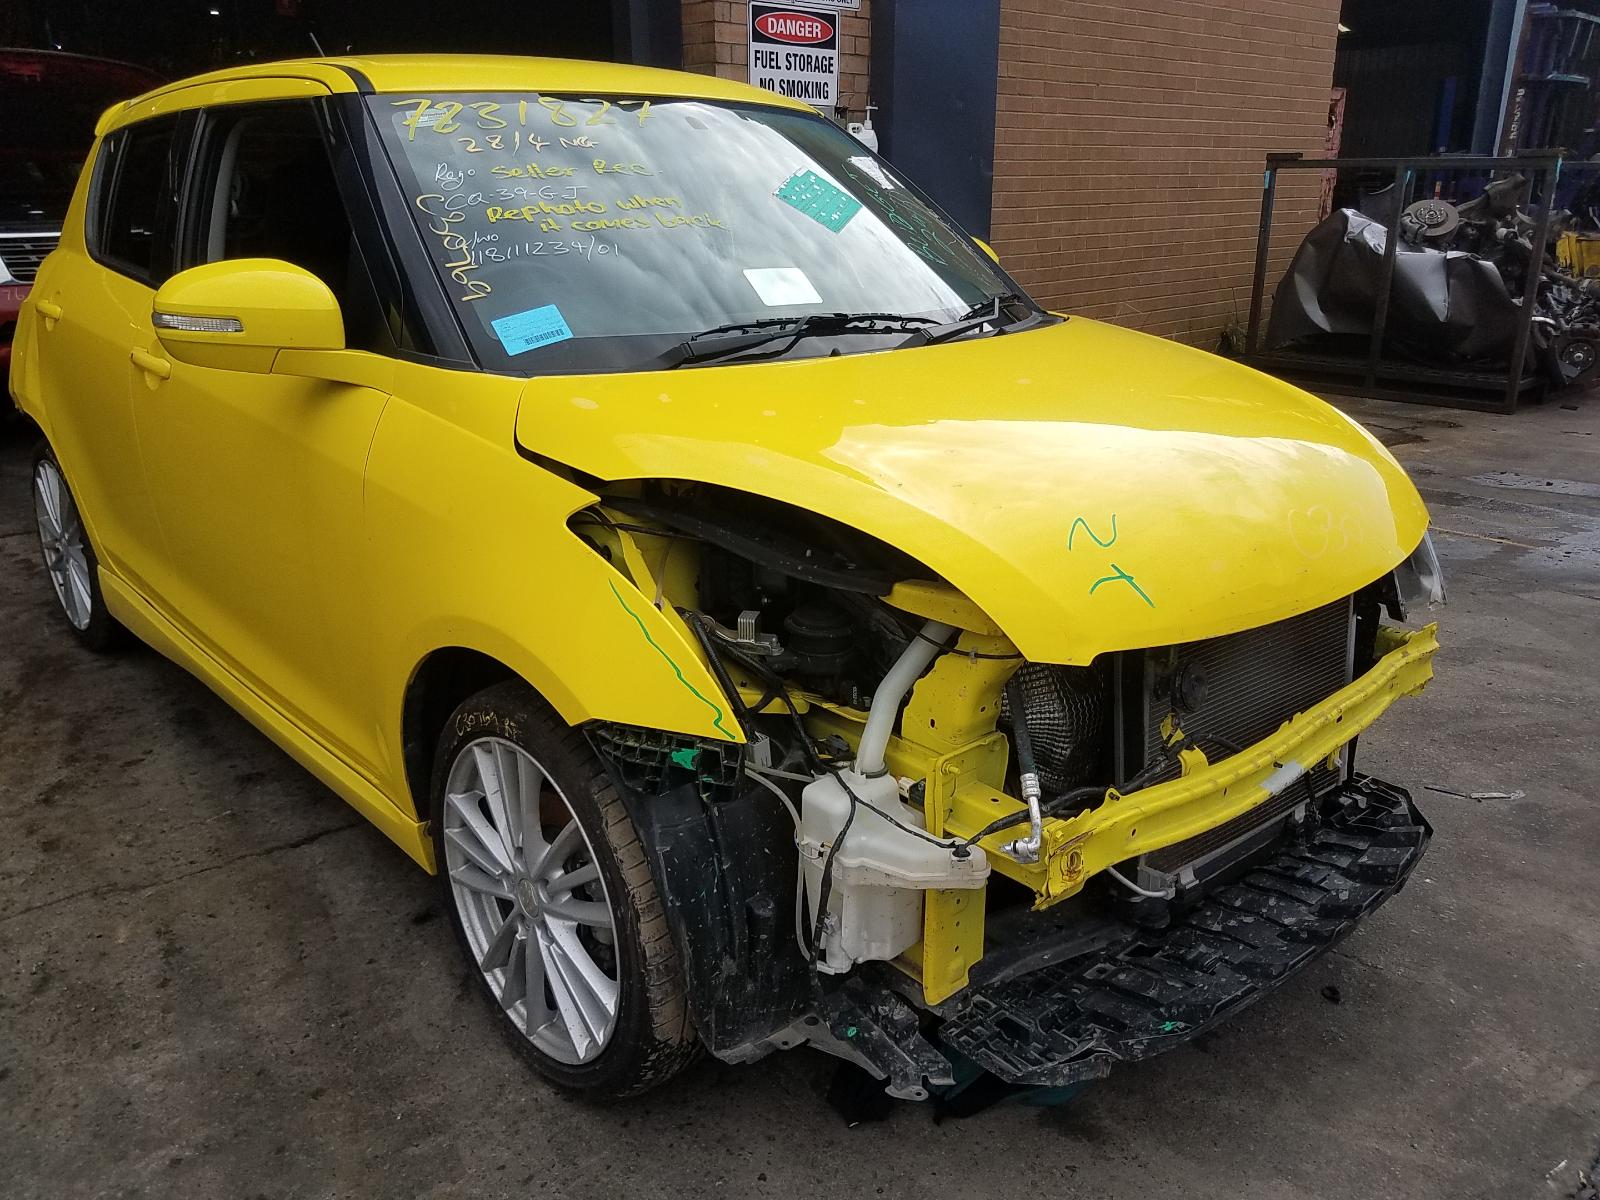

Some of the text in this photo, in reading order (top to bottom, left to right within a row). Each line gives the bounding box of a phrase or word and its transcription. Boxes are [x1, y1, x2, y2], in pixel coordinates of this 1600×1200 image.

[767, 17, 822, 38] DANGER
[754, 50, 834, 74] FUEL STORAGE
[759, 77, 829, 100] NO SMOKING
[486, 194, 683, 224] Rephoto when
[540, 213, 727, 233] it comes back
